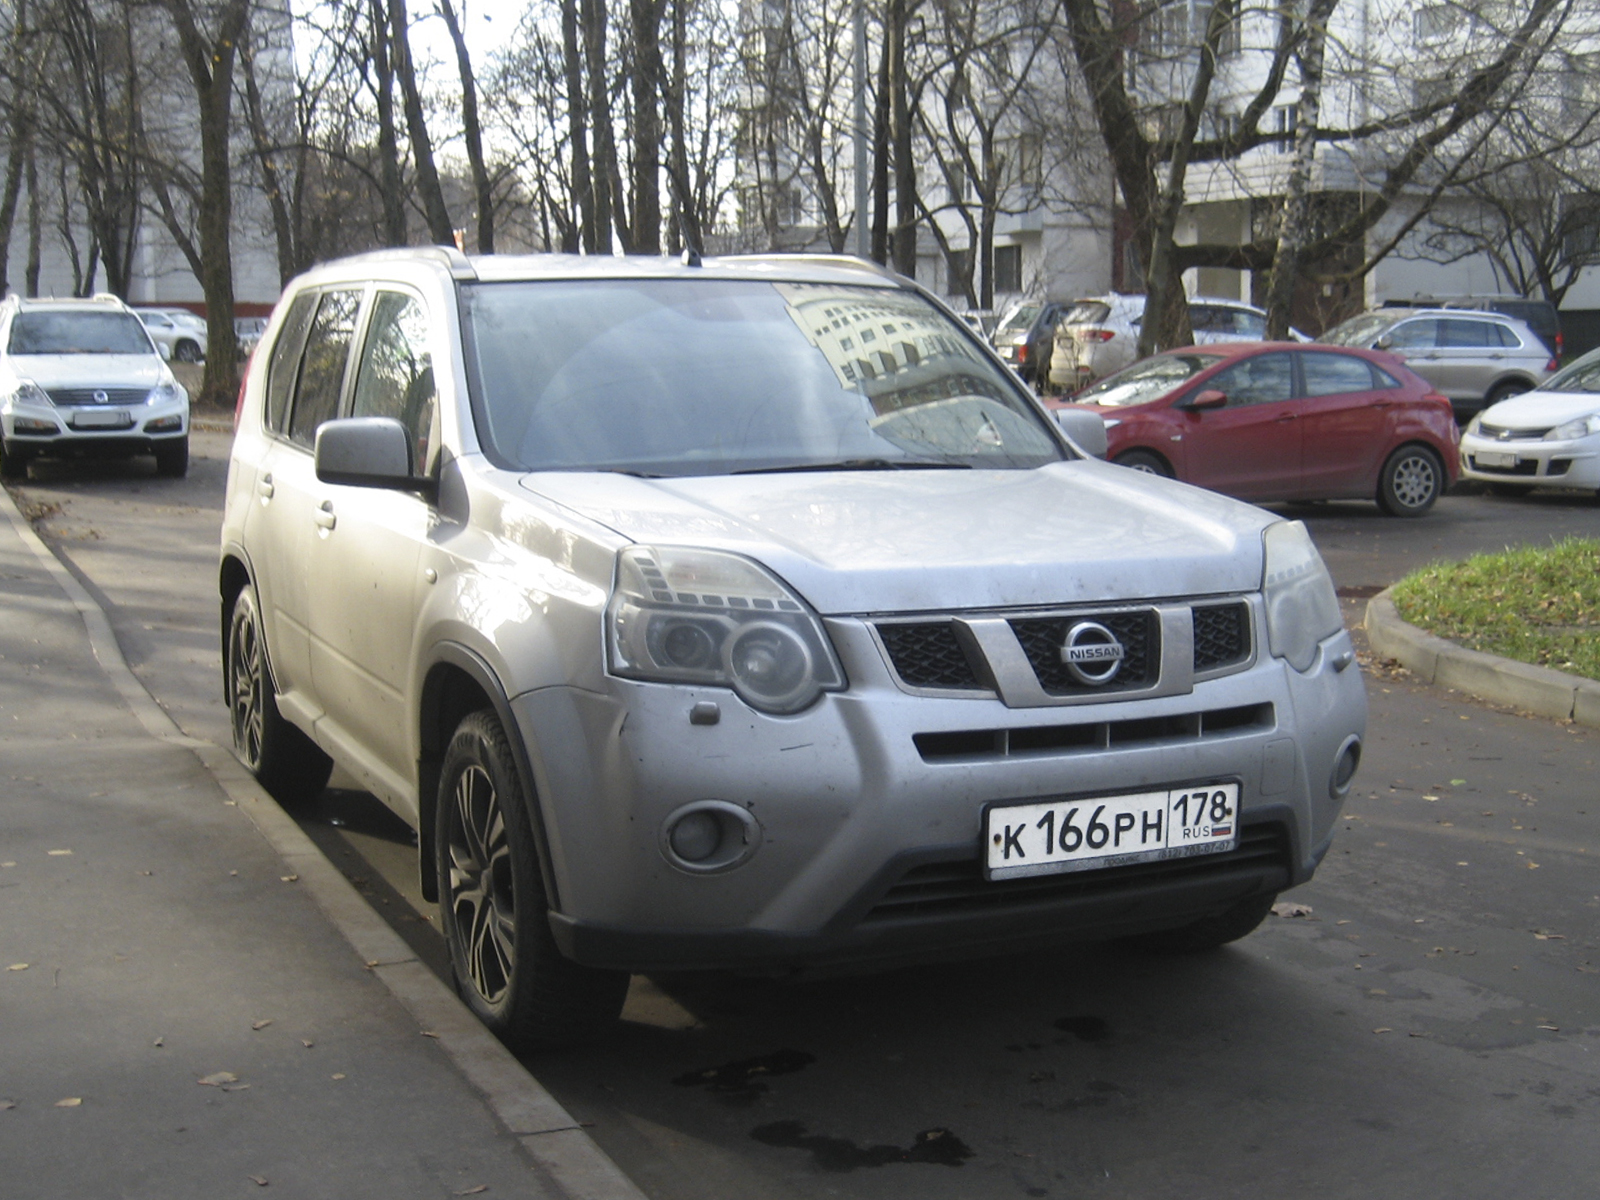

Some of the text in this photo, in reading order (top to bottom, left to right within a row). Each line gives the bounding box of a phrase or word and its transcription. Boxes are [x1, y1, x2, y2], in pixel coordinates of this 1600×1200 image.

[1070, 647, 1120, 660] NISSAN
[1173, 790, 1227, 827] 178
[1183, 825, 1210, 839] RUS
